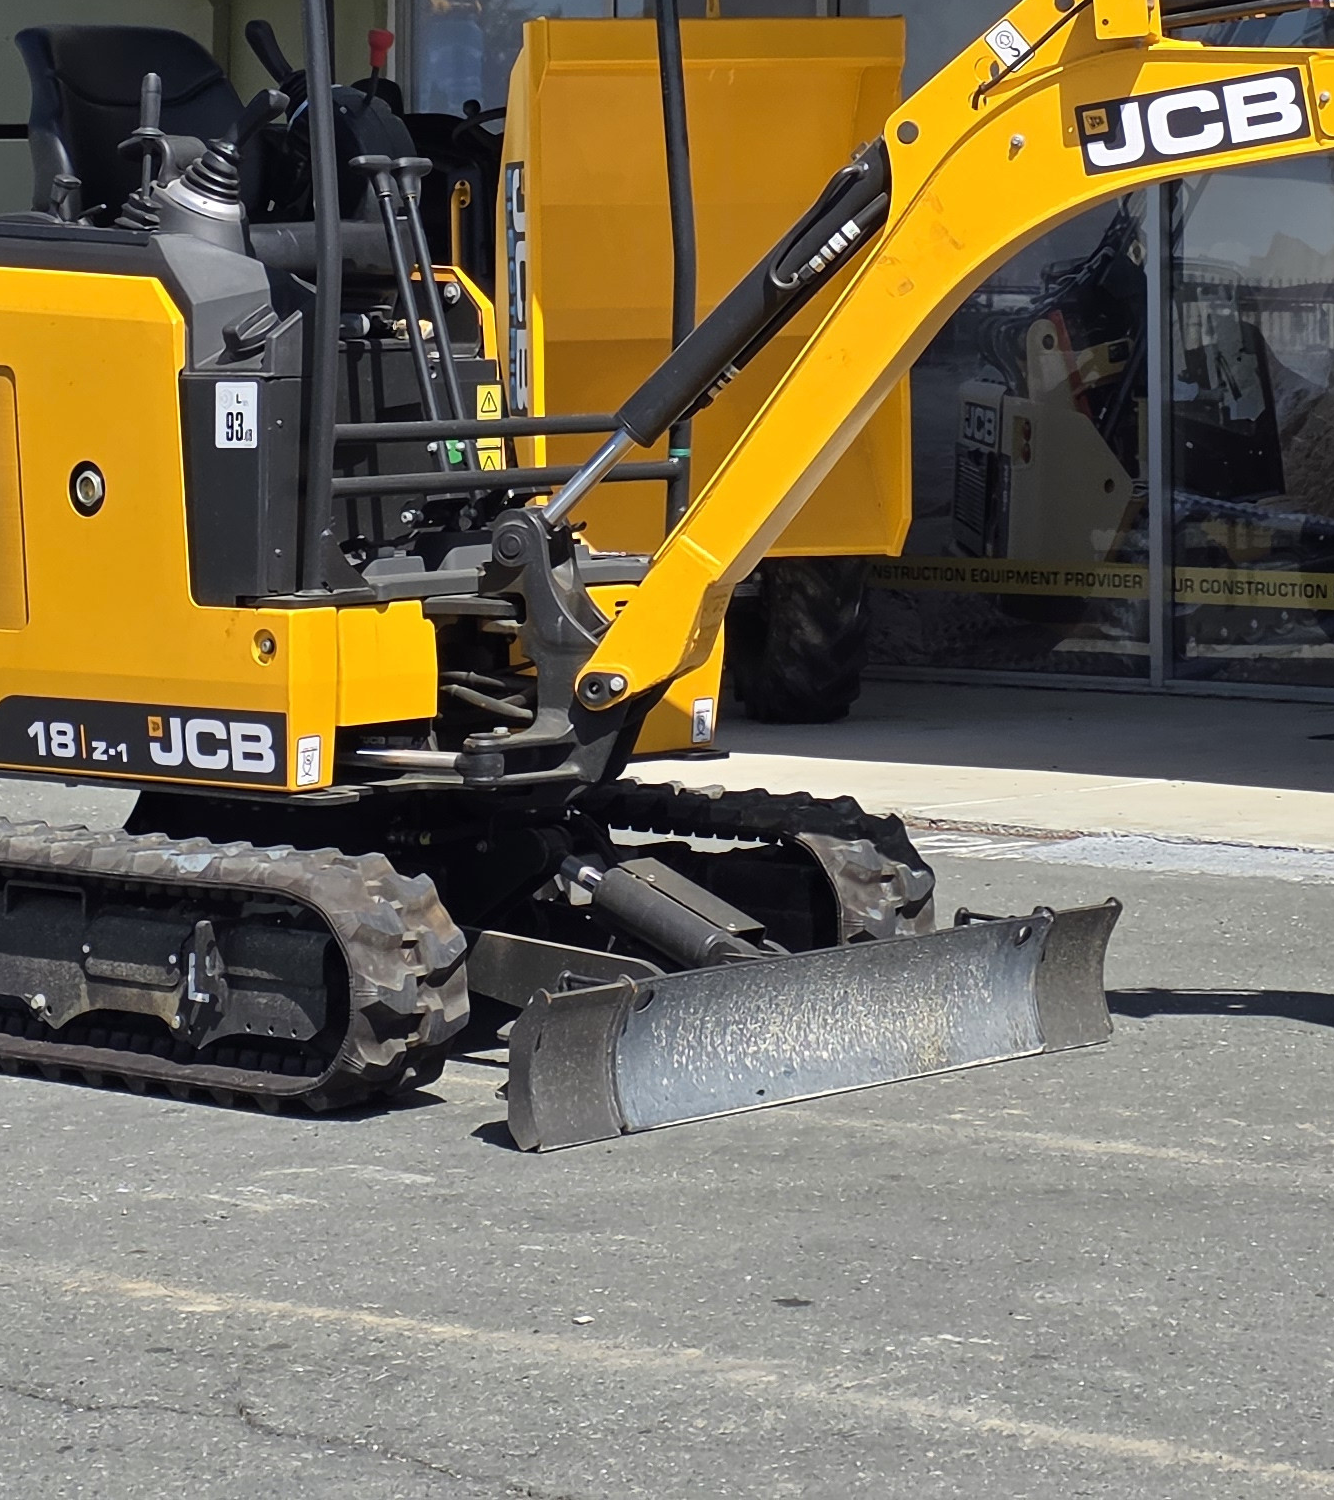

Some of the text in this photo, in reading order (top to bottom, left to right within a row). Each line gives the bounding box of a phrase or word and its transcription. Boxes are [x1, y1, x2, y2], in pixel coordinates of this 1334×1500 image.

[1087, 76, 1303, 167] JCB
[872, 564, 1143, 590] NSTRUCTION EQUIPMENT PROVIDER
[1171, 578, 1194, 593] UR
[1200, 579, 1327, 600] CONSTRUCTION
[27, 721, 76, 758] 18
[149, 717, 275, 773] JCB
